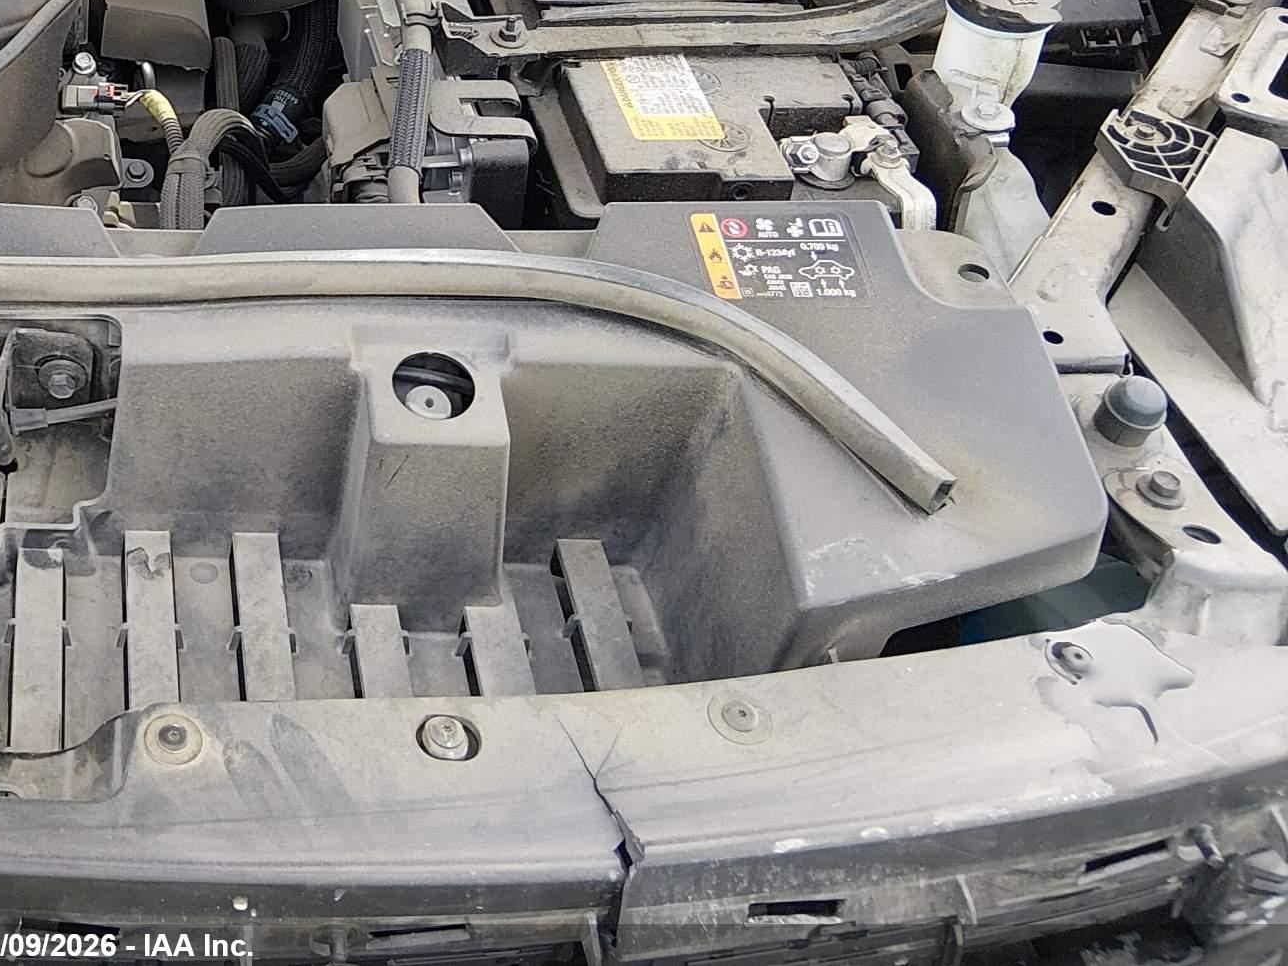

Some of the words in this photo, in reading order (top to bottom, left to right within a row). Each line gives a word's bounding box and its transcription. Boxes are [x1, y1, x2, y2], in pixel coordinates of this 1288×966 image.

[799, 242, 825, 251] 0.700
[825, 242, 839, 252] kg
[755, 248, 796, 258] R-1234yf
[760, 265, 781, 274] PAG
[816, 288, 842, 296] 1.000
[843, 289, 857, 298] kg
